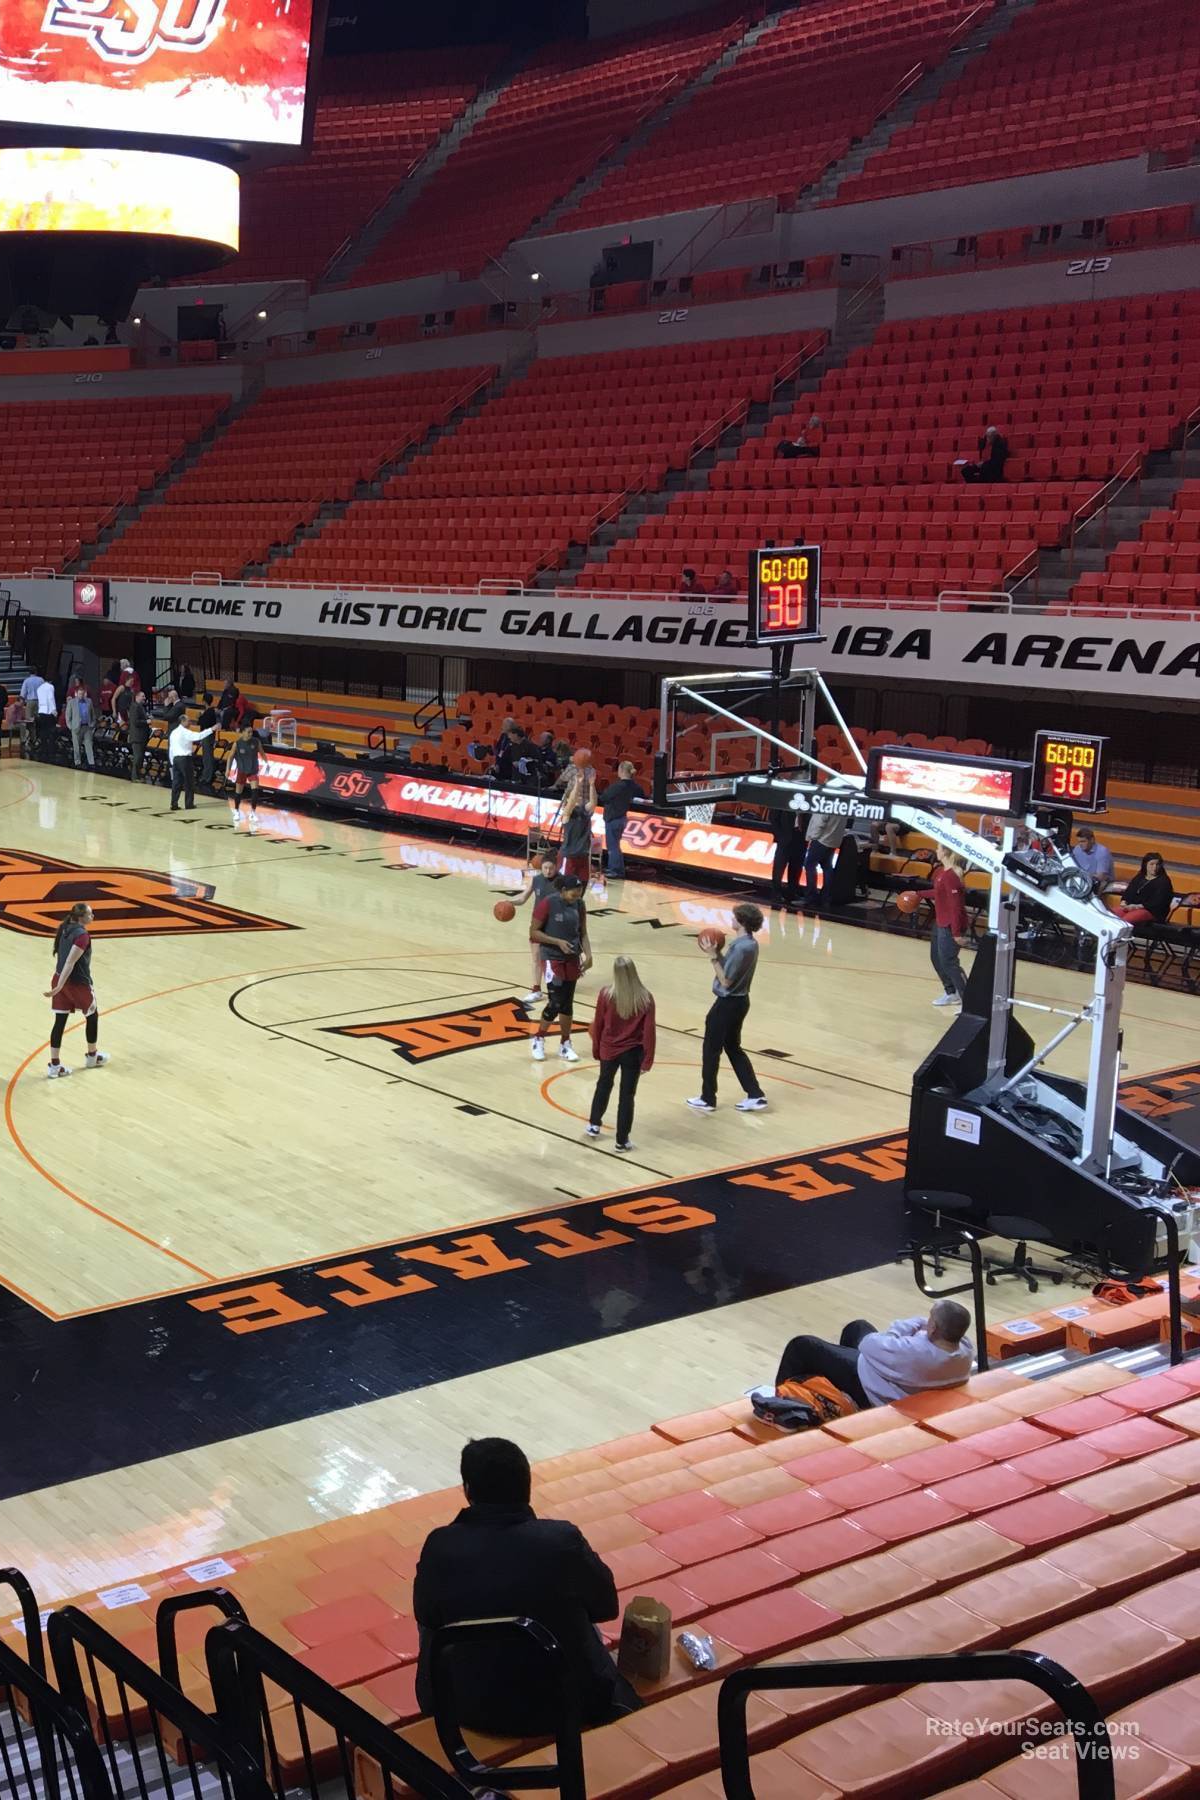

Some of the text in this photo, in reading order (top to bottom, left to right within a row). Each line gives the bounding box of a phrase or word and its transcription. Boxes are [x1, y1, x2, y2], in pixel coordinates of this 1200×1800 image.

[1066, 257, 1112, 275] 213
[658, 309, 689, 323] 212
[75, 373, 103, 384] 210
[761, 557, 809, 583] 60:00
[768, 584, 802, 627] 30
[149, 596, 244, 616] WELCOME
[251, 600, 282, 618] TO
[319, 602, 487, 633] HISTORIC
[962, 632, 1200, 676] ARENA
[1046, 743, 1095, 768] 60:00
[331, 770, 373, 797] OSU
[1054, 767, 1085, 796] 30
[400, 782, 528, 819] OKLAHOMA
[622, 814, 680, 847] OSU
[964, 844, 994, 867] Sports
[187, 1196, 716, 1335] STATE
